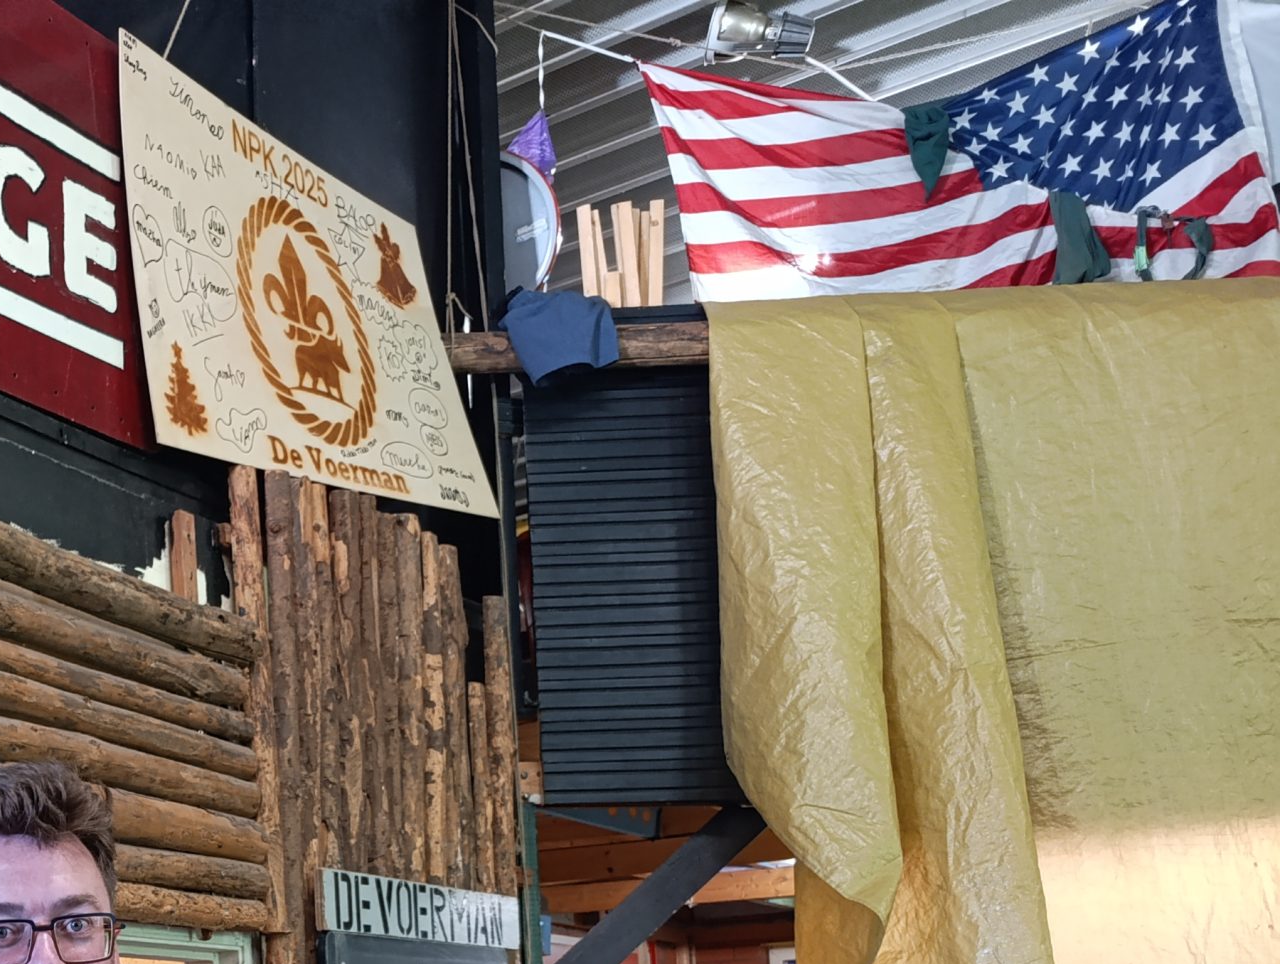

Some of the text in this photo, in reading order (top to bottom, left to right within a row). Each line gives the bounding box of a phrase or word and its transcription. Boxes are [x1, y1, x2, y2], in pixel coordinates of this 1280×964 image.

[232, 119, 328, 208] NPK 2025
[267, 435, 304, 469] De
[305, 445, 410, 495] Voerman
[334, 871, 503, 946] DE VOERMAN
